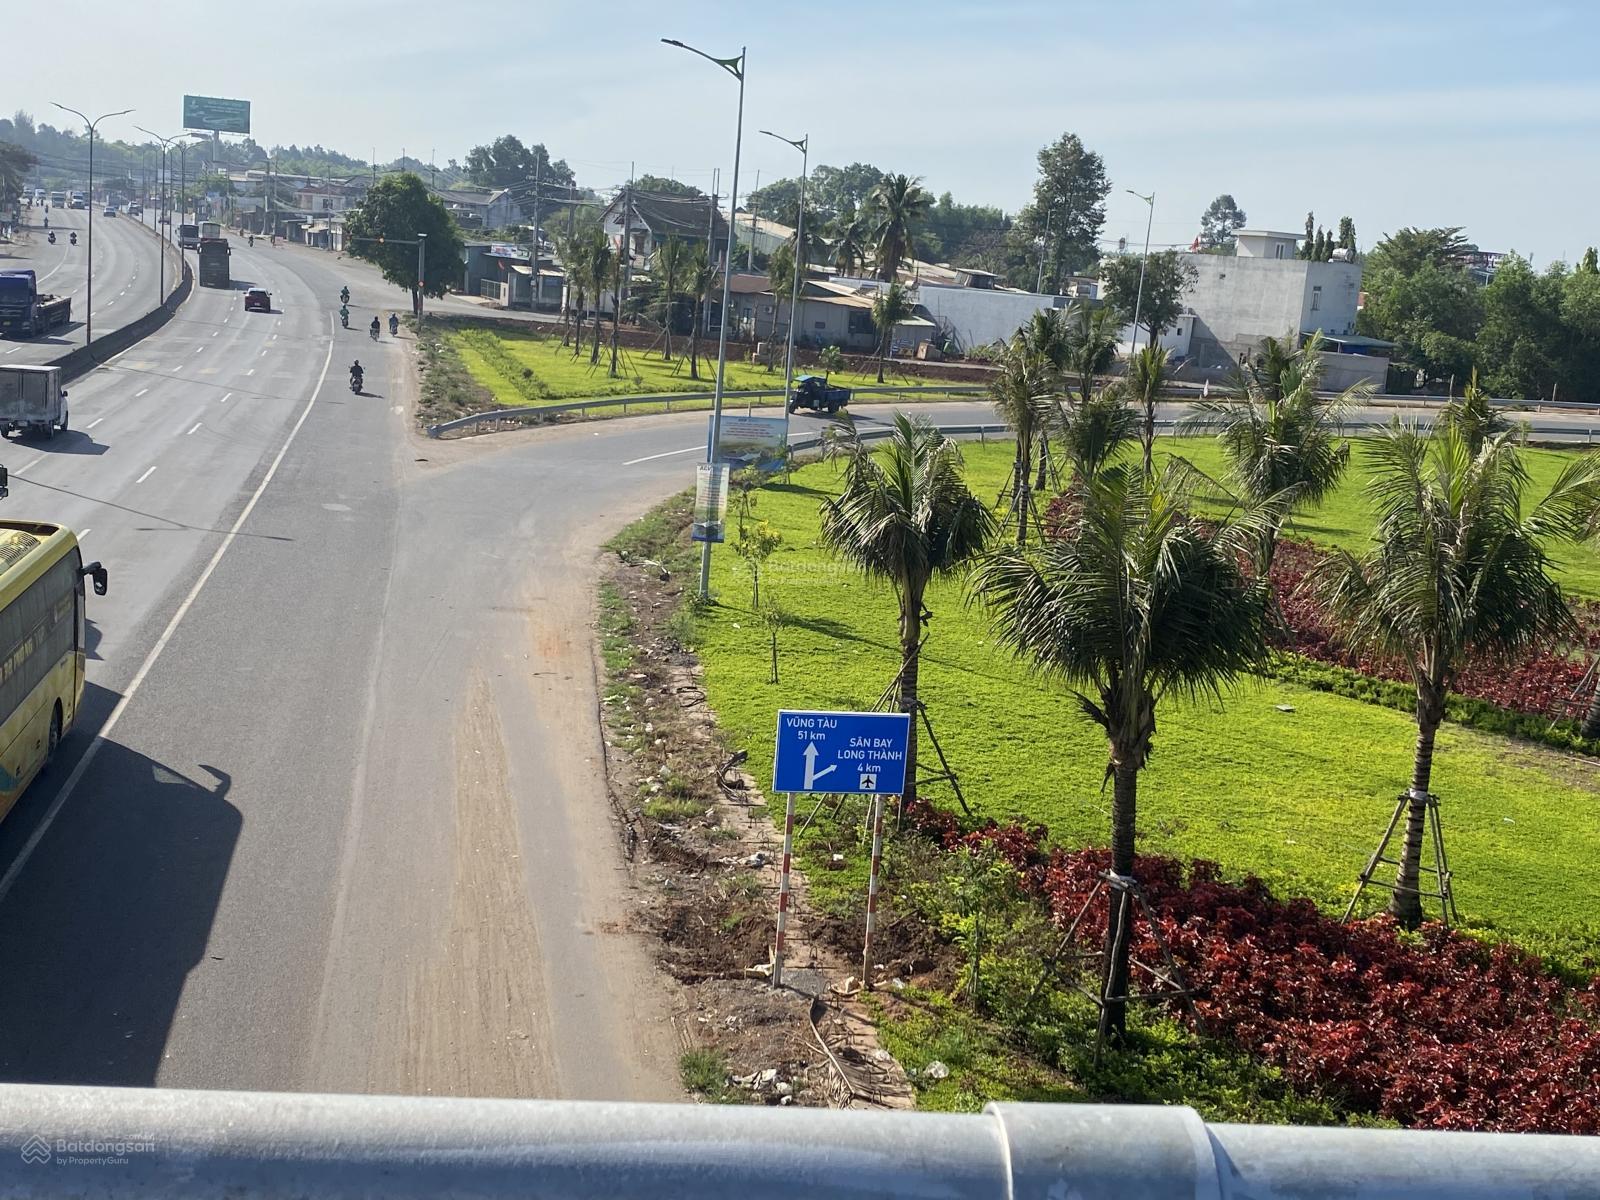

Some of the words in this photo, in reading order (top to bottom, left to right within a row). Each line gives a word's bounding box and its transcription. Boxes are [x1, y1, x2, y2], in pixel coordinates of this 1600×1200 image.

[787, 717, 815, 728] VŨNG
[818, 717, 838, 729] TÀU
[797, 731, 808, 740] 51
[810, 731, 826, 741] km
[850, 736, 871, 748] SÂN
[874, 738, 893, 748] BAY
[837, 750, 865, 760] LONG
[868, 749, 903, 761] THÀNH
[857, 763, 864, 772] 4
[865, 763, 881, 773] km
